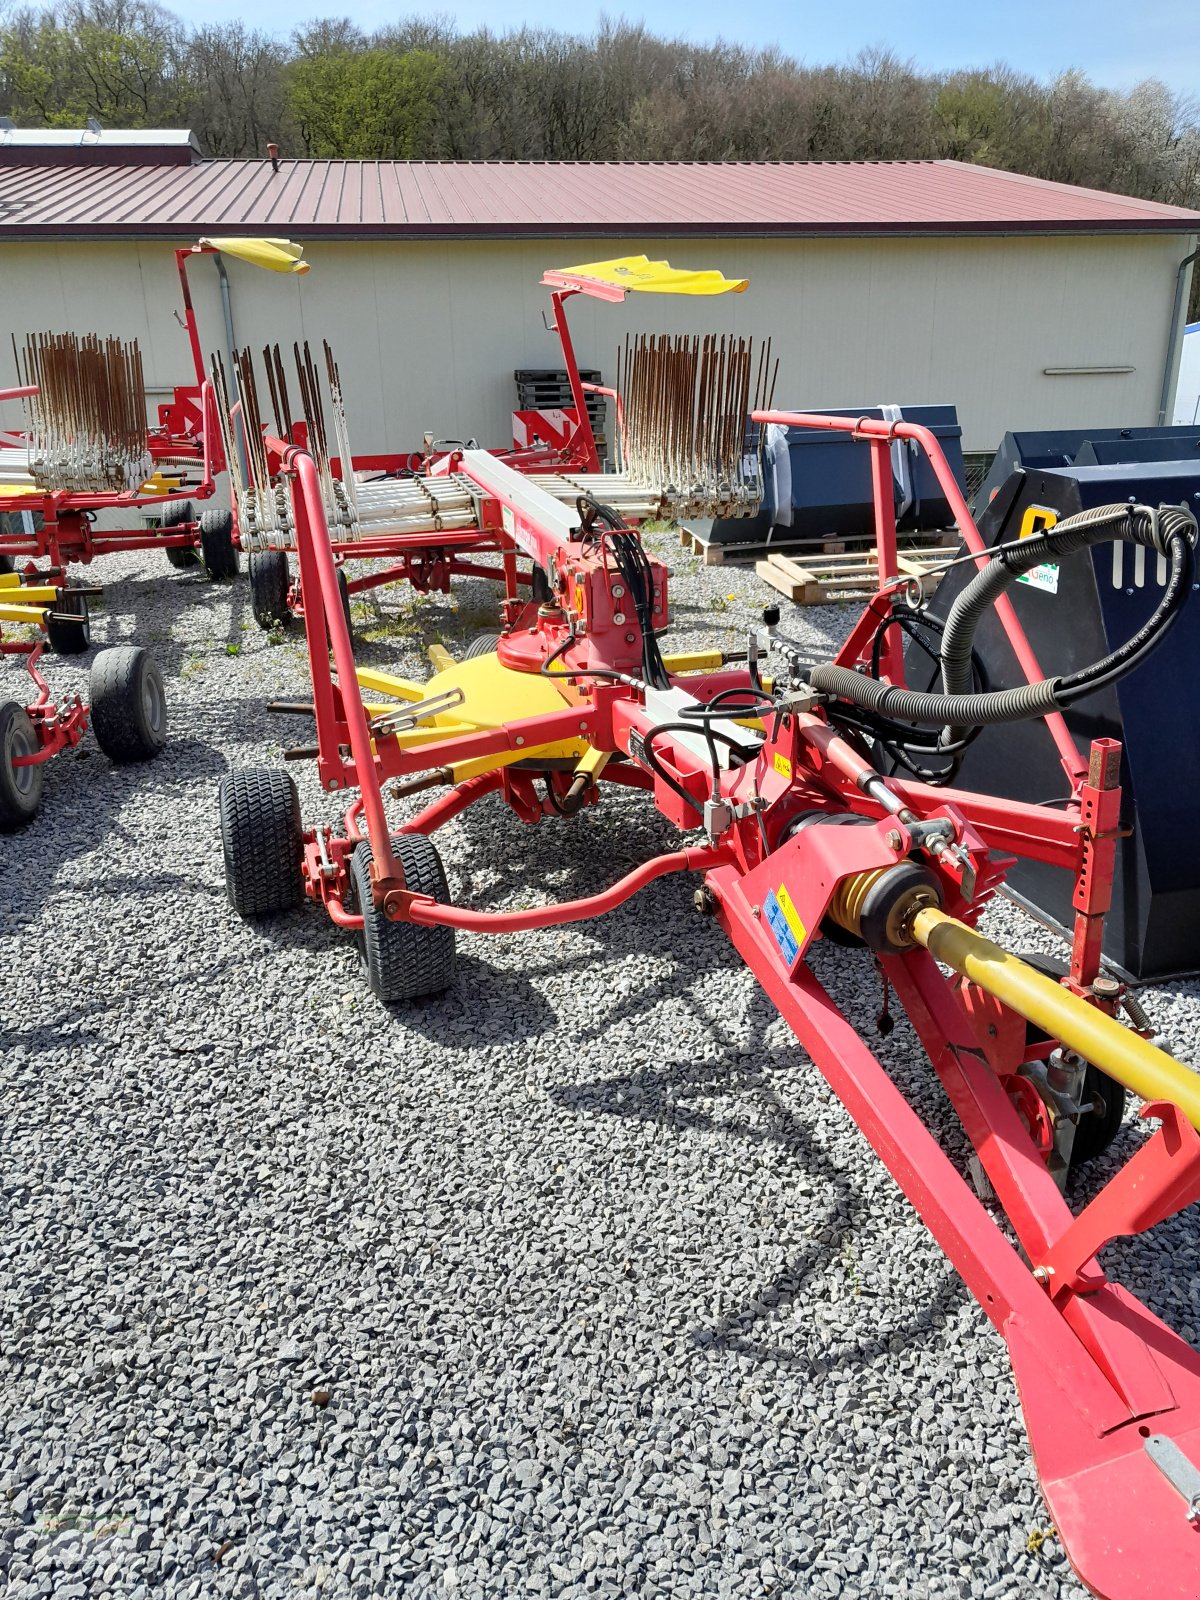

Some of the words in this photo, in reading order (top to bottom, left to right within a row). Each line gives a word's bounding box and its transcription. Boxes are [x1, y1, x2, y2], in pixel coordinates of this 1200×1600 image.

[1174, 546, 1182, 560] WP
[1027, 569, 1054, 584] Geno
[1171, 574, 1180, 587] DN
[1129, 637, 1140, 648] EN
[1119, 645, 1131, 656] DIN
